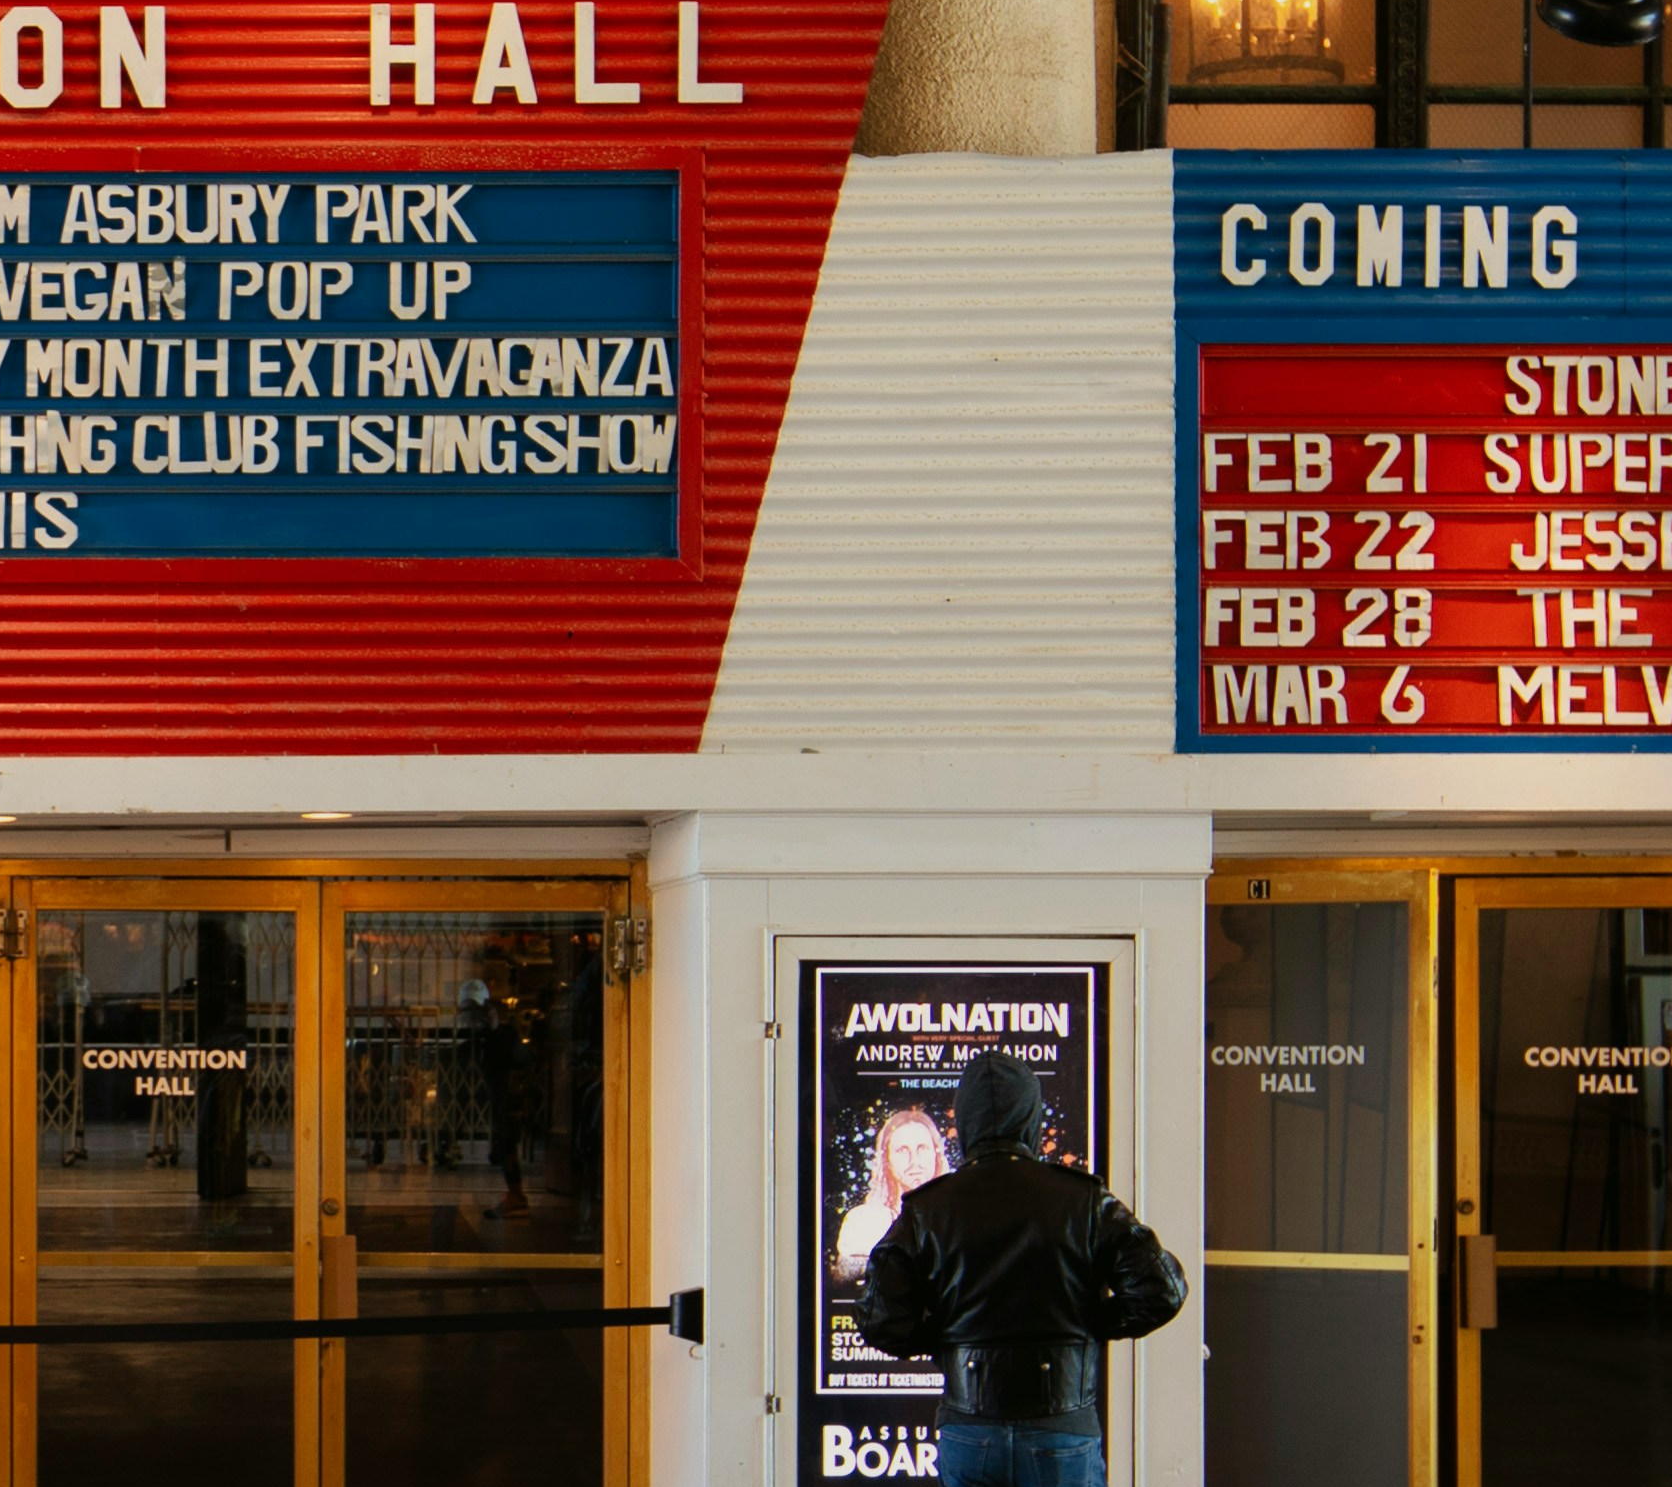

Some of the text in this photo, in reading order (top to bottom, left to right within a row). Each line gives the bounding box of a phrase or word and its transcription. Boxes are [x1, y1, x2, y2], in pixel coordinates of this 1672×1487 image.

[369, 1, 744, 105] HALL
[60, 184, 290, 244] ASBURY
[314, 184, 478, 244] PARK
[1220, 203, 1579, 290] COMING
[219, 261, 354, 321] POP
[389, 261, 472, 321] UP
[25, 338, 229, 398] MONTH
[248, 338, 675, 398] EXTRAVAGANZA
[132, 412, 279, 475] CLUB
[1203, 432, 1333, 494] FEB
[1363, 432, 1428, 494] 21
[1203, 510, 1332, 571] FEB
[1353, 510, 1436, 571] 22
[1204, 587, 1316, 648] FEB
[1342, 587, 1433, 648] 28
[1516, 587, 1654, 648] THE
[1213, 664, 1349, 726] MAR
[1381, 664, 1426, 725] 6
[845, 1003, 1069, 1038] AWOLNATION
[82, 1049, 247, 1070] CONVENTION
[856, 1044, 945, 1062] ANDREW
[1211, 1045, 1365, 1065] CONVENTION
[1260, 1072, 1316, 1093] HALL
[135, 1076, 196, 1096] HALL
[900, 1079, 921, 1089] THE
[1578, 1074, 1639, 1094] HALL
